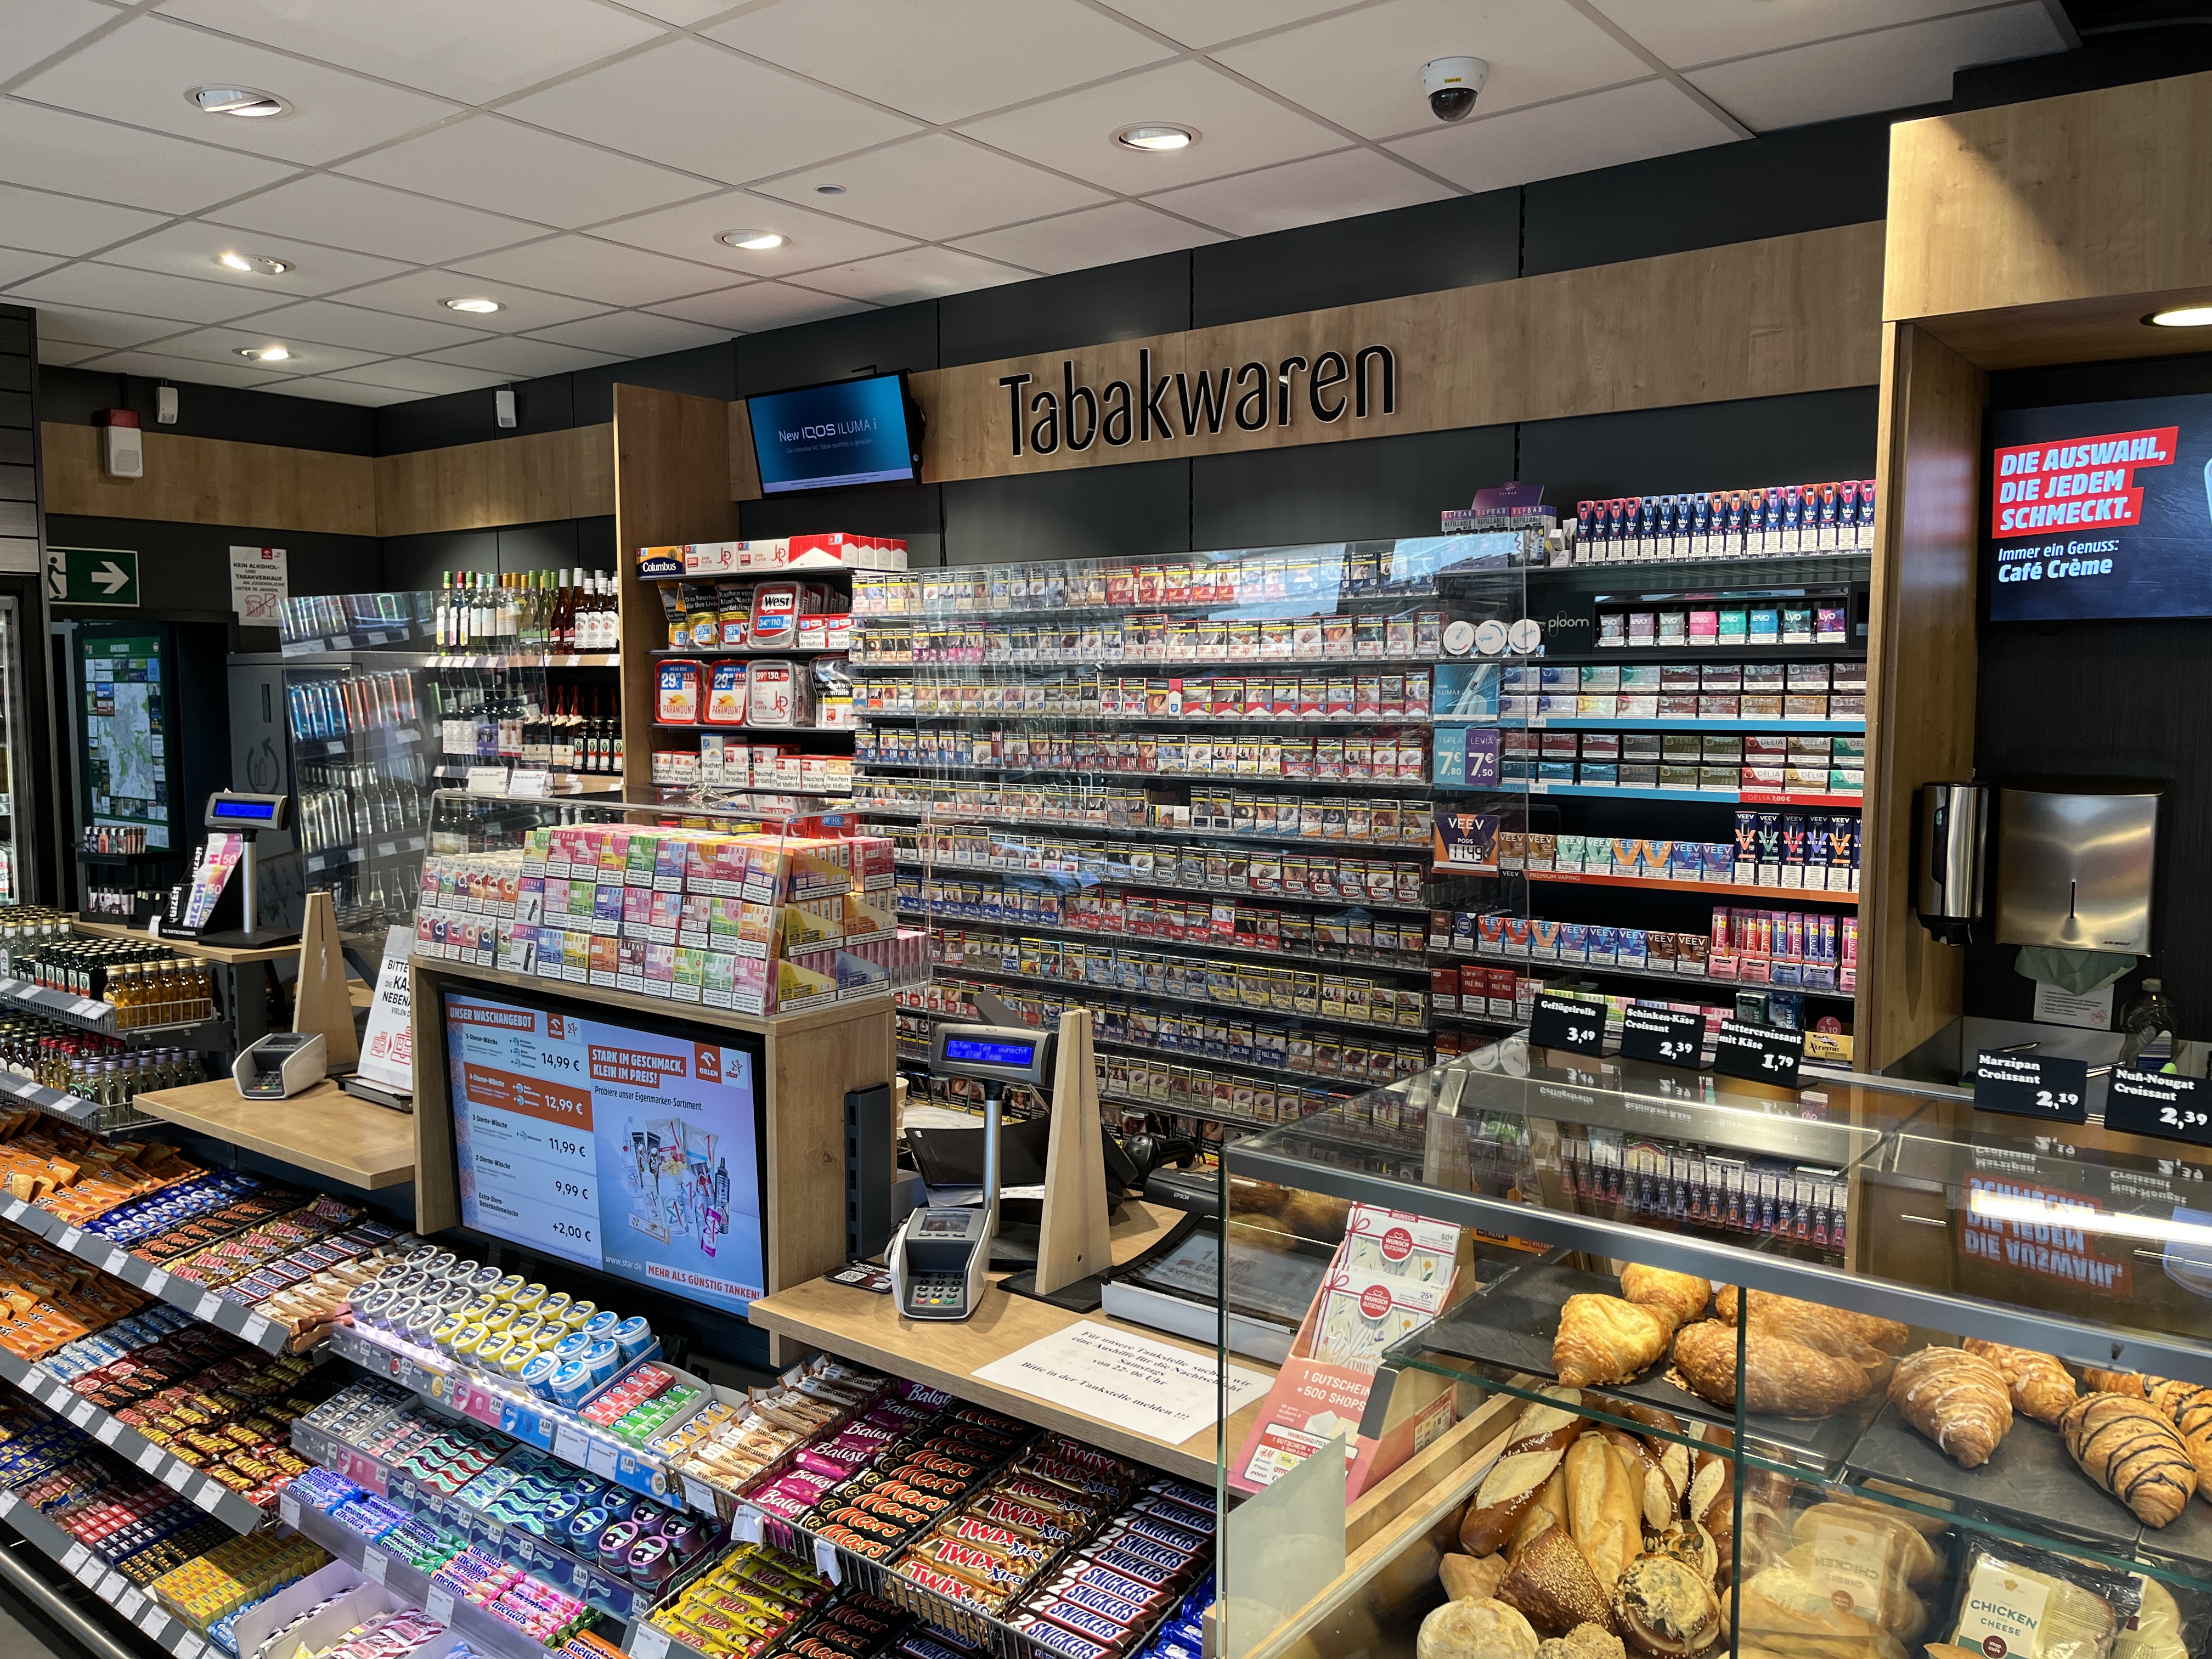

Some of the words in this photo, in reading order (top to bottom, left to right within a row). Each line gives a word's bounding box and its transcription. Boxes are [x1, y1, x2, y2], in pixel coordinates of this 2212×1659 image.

[999, 344, 1395, 457] Tabakwaren
[779, 430, 799, 442] New
[802, 424, 836, 439] IQOS
[838, 419, 871, 435] ILUMA
[2000, 452, 2040, 476] DIE
[2042, 437, 2166, 471] AUSWAHL,
[2000, 479, 2040, 504] DIE
[2045, 469, 2125, 499] JEDEM
[1513, 506, 1542, 515] ELFBAR
[2000, 497, 2132, 531] SCHMECKT.
[1999, 547, 2040, 561] Immer
[2044, 543, 2064, 557] ein
[2068, 539, 2119, 555] Genuss:
[643, 562, 676, 572] Columbus
[1999, 561, 2042, 583] Café
[2047, 558, 2113, 579] Crème
[765, 596, 789, 606] West
[1549, 611, 1589, 637] ploom
[663, 704, 695, 714] PARAMOUNT
[713, 705, 742, 715] PARAMOUNT
[1448, 817, 1484, 830] VEEV
[223, 854, 236, 864] 50
[1454, 845, 1482, 860] 11.49
[207, 885, 222, 894] 50
[1648, 934, 1673, 943] VEEV
[388, 960, 408, 973] BITTE
[392, 1007, 406, 1016] VIELEN
[450, 1007, 472, 1020] UNSER
[473, 1010, 532, 1028] WASCHANGEBOT
[1541, 1001, 1596, 1016] Geflügelrolle
[1627, 1008, 1695, 1025] Schinken-Käse
[1625, 1019, 1670, 1033] Croissant
[1721, 1020, 1802, 1045] Buttercroissant
[1567, 1027, 1595, 1044] 3,49
[1719, 1035, 1737, 1045] mit
[1738, 1037, 1763, 1049] Käse
[1659, 1041, 1693, 1060] 2,39
[1809, 1042, 1839, 1053] Xtreme
[542, 1052, 569, 1069] 14,99
[573, 1060, 579, 1071] €
[592, 1048, 617, 1063] STARK
[620, 1052, 629, 1065] IM
[631, 1054, 683, 1074] GESCHMACK,
[1762, 1054, 1794, 1071] 1,79
[1978, 1054, 2040, 1071] Marzipan
[594, 1064, 617, 1078] KLEIN
[619, 1068, 627, 1080] IM
[630, 1069, 657, 1085] PREIS!
[699, 1068, 718, 1077] ORLEN
[725, 1070, 738, 1079] star
[1978, 1069, 2041, 1085] Croissant
[2115, 1069, 2195, 1091] Nuß-Nougat
[595, 1086, 618, 1097] Probiere
[619, 1091, 634, 1099] unser
[635, 1092, 703, 1111] Eigenmarken-Sortiment.
[2036, 1091, 2079, 1110] 2,19
[2114, 1083, 2177, 1101] Croissant
[544, 1095, 573, 1112] 12,99
[576, 1103, 583, 1115] €
[2159, 1107, 2208, 1130] 2,39
[549, 1138, 575, 1154] 11,99
[579, 1146, 585, 1157] €
[556, 1181, 578, 1196] 9,99
[582, 1189, 588, 1200] €
[553, 1222, 581, 1238] +2,00
[585, 1231, 591, 1242] €
[1384, 1245, 1408, 1254] GUTSCHEIN
[1386, 1237, 1409, 1248] WUNSCH
[606, 1256, 642, 1271] www.star.de
[648, 1265, 670, 1278] MEHR
[672, 1271, 686, 1282] ALS
[689, 1274, 722, 1291] GÜNSTIG
[725, 1283, 760, 1300] TANKEN!
[1363, 1302, 1386, 1311] GUTSCHEIN
[1364, 1295, 1388, 1305] WUNSCH
[1081, 1331, 1102, 1340] Für
[1102, 1338, 1134, 1350] unsere
[1137, 1348, 1188, 1367] Tankstelle
[1233, 1379, 1252, 1387] wir
[1093, 1344, 1135, 1358] Aushilfe
[1118, 1358, 1166, 1376] Samstags
[1304, 1370, 1309, 1380] 1
[1146, 1375, 1167, 1386] Uhr
[1020, 1362, 1046, 1372] Bitte
[1058, 1374, 1077, 1383] der
[1078, 1379, 1131, 1401] Tankstelle
[1133, 1400, 1172, 1415] melden
[1174, 1412, 1190, 1420] !!!
[1304, 1386, 1327, 1400] 500
[1329, 1392, 1367, 1411] SHOPS
[586, 1406, 602, 1417] extra
[878, 1400, 930, 1420] Balisto
[614, 1419, 634, 1430] extra
[624, 1459, 633, 1467] 1,69
[312, 1468, 341, 1487] mentos
[289, 1485, 316, 1504] mentos
[872, 1480, 950, 1511] Mars
[851, 1493, 929, 1523] Mars
[827, 1506, 906, 1537] Mars
[1007, 1542, 1043, 1562] Xtra
[576, 1570, 586, 1579] 3,99
[986, 1566, 1025, 1585] Xtra
[492, 1601, 528, 1625] mentos
[1069, 1585, 1140, 1623] SNICKERS
[1051, 1603, 1121, 1639] SNICKERS
[1971, 1600, 2038, 1629] CHICKEN
[1980, 1618, 2021, 1636] CHEESE
